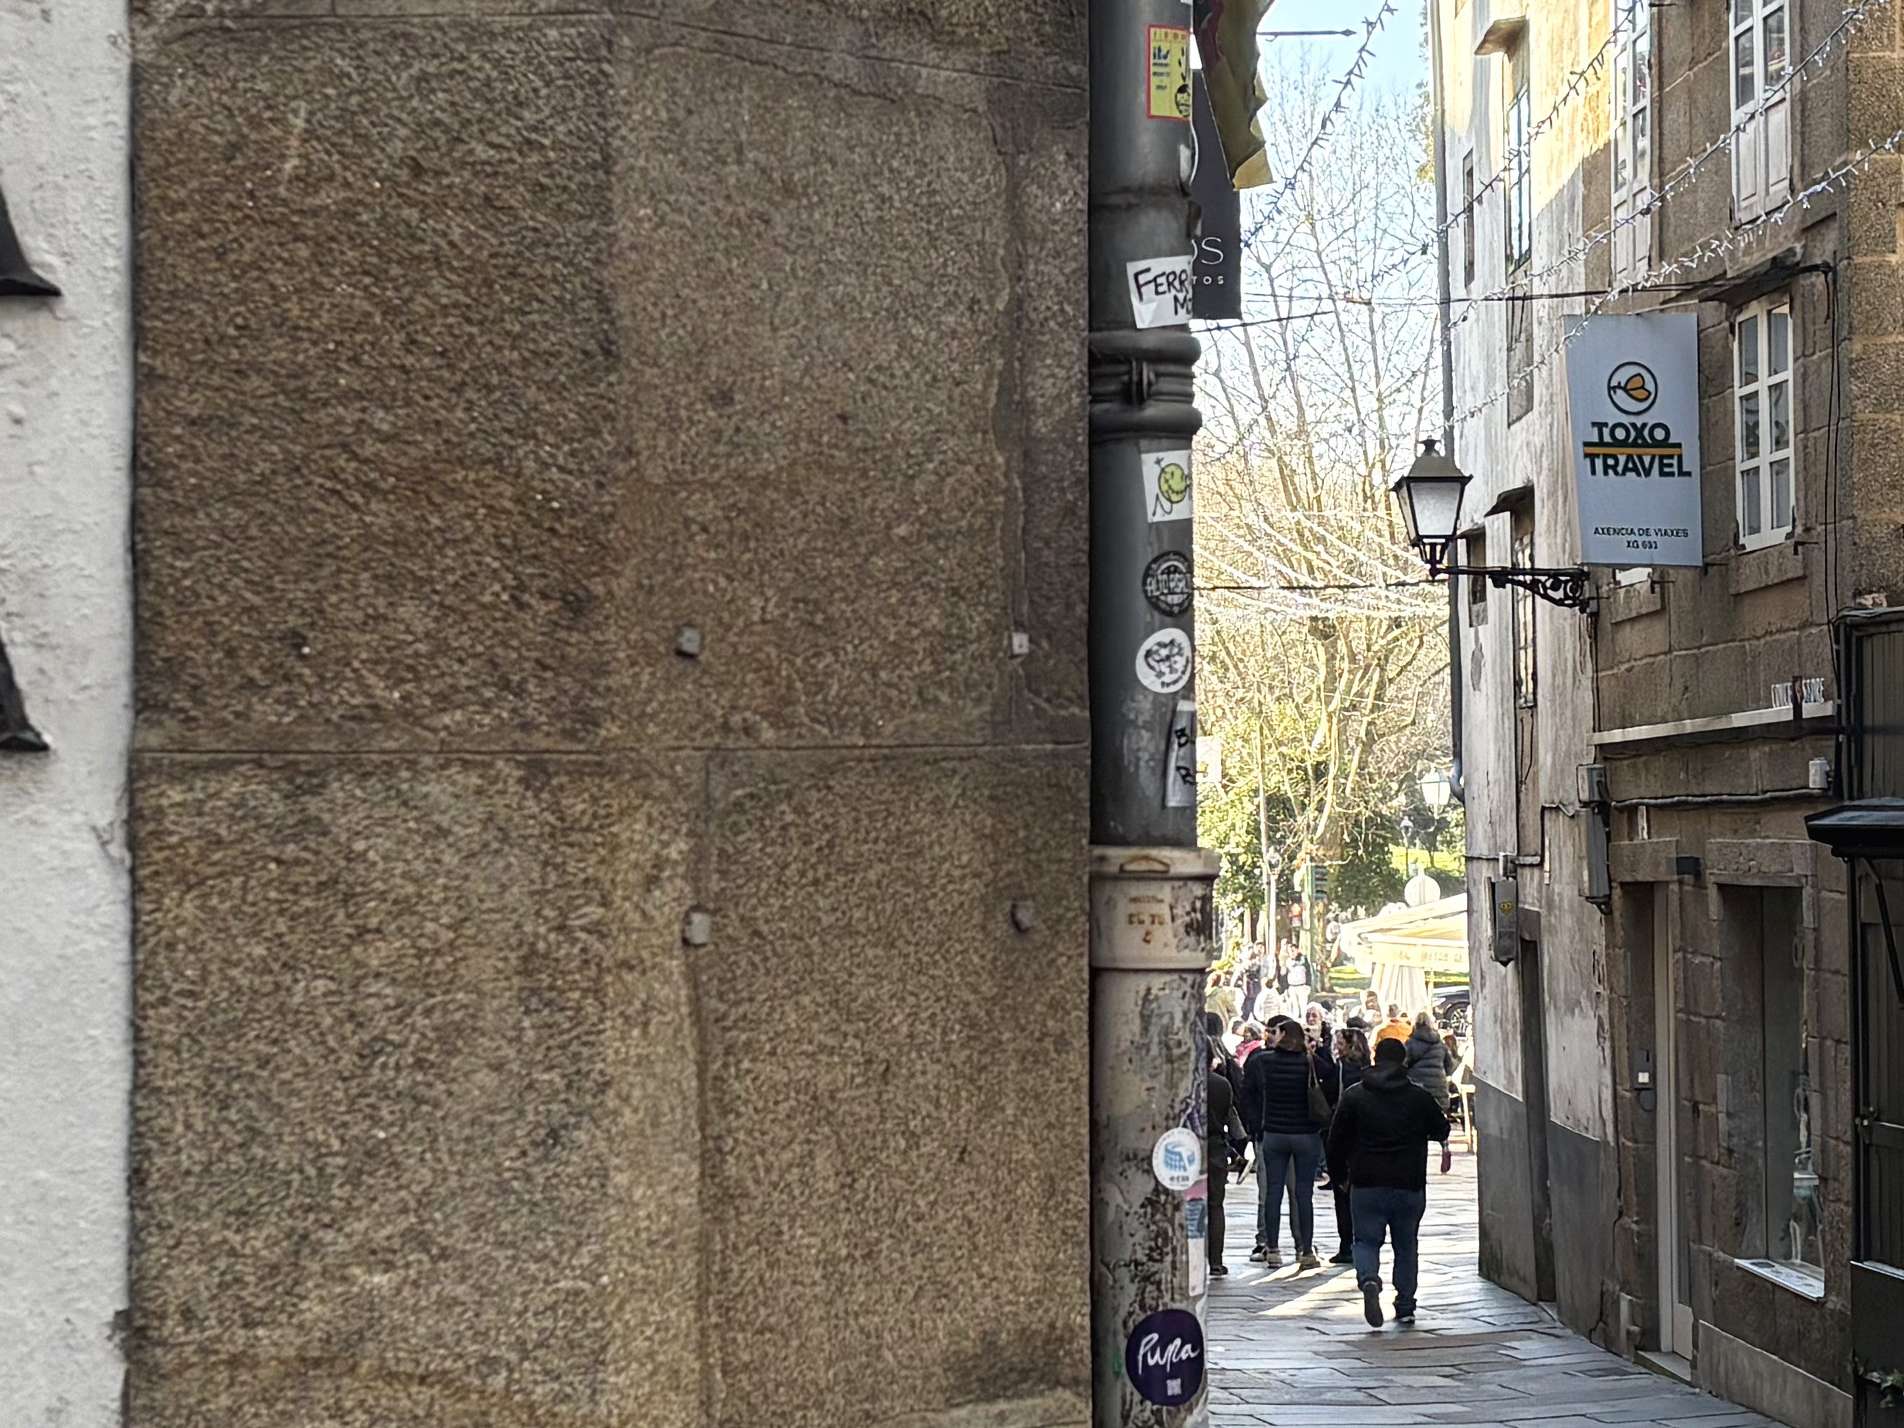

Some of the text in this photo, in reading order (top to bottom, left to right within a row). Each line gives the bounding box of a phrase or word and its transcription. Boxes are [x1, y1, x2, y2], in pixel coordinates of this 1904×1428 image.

[1591, 422, 1671, 444] TOXO
[1585, 454, 1692, 477] TRAVEL
[1593, 527, 1689, 538] AXENCIA DE VIAXES
